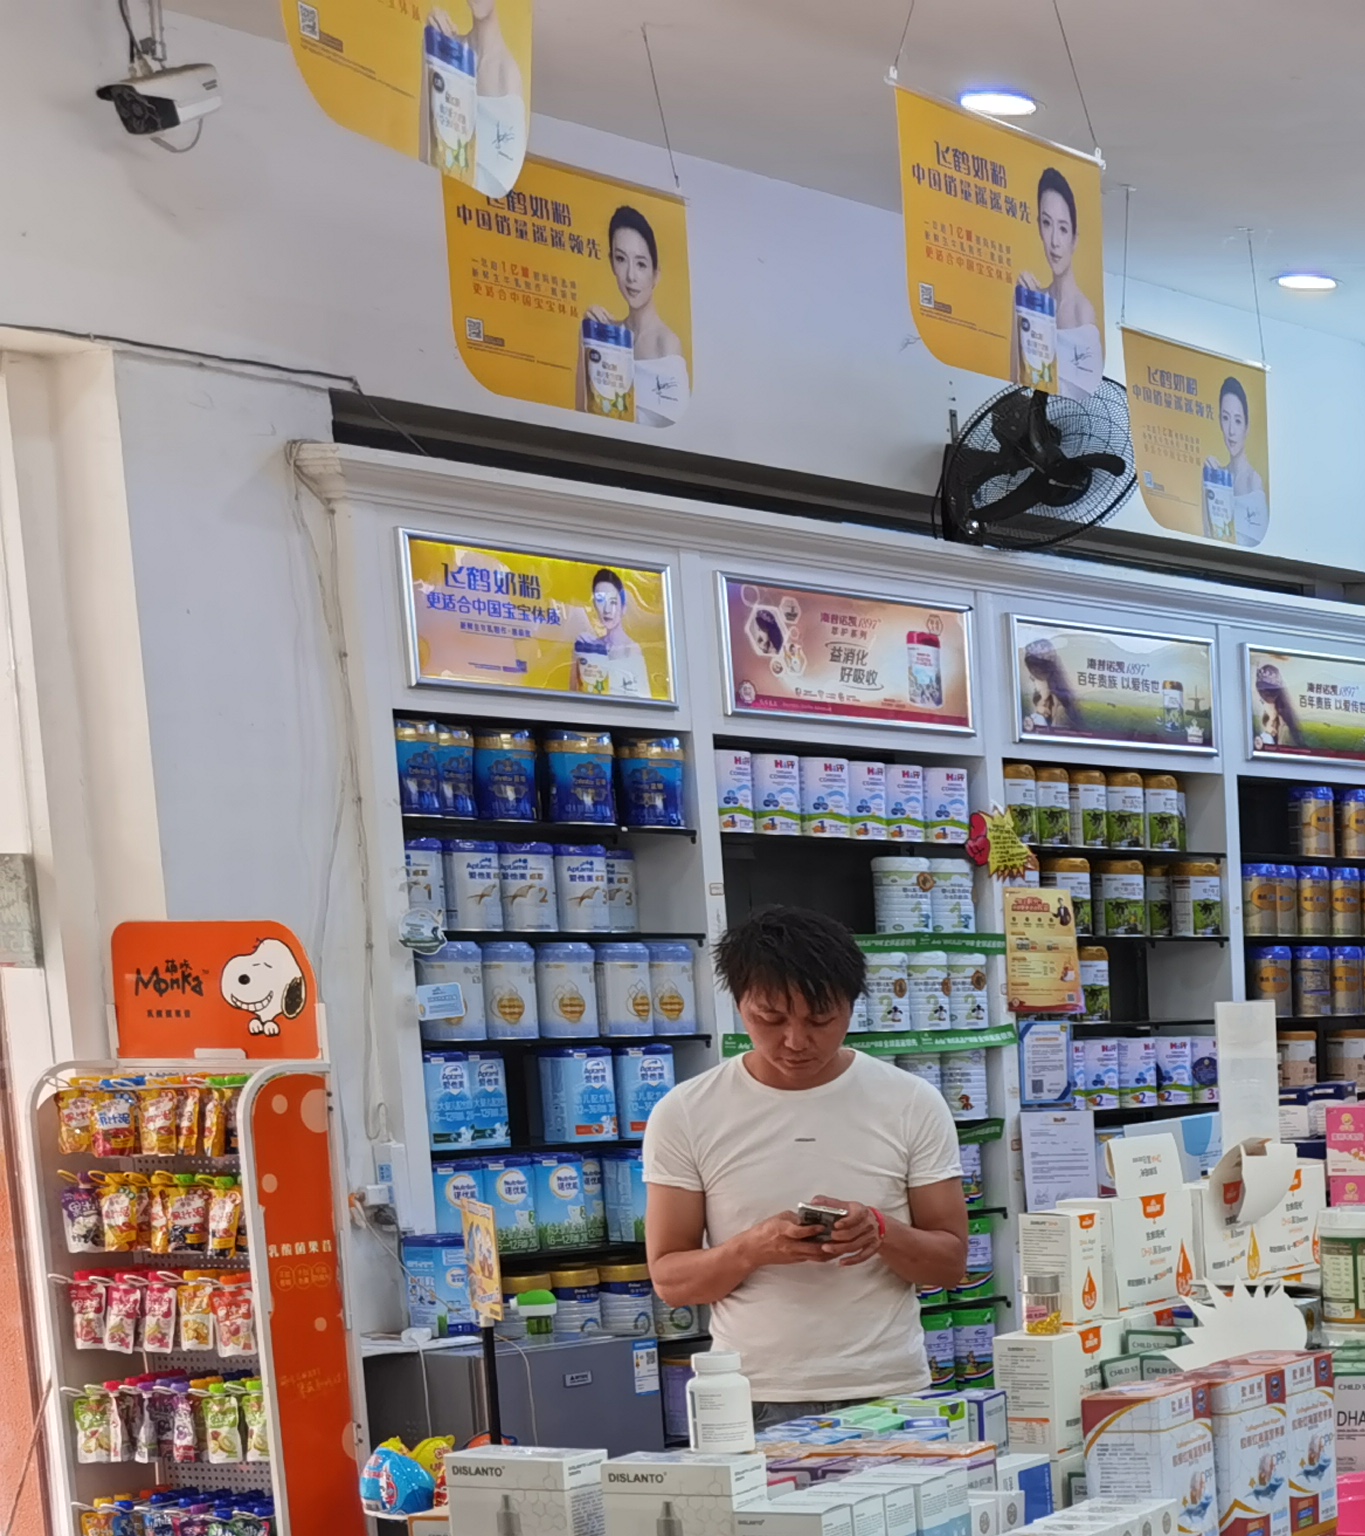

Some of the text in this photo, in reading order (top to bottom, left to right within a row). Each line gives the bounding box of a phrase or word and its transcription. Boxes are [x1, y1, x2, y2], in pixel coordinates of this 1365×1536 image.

[934, 140, 1008, 189] 飞鹤奶粉
[457, 204, 601, 260] 中国销量遥遥领先
[442, 562, 541, 600] 飞鹤奶粉
[426, 589, 561, 627] 更适合中国宝宝体质
[828, 646, 868, 667] 益消化
[1077, 672, 1161, 694] 百年贵族 以爱传世
[1298, 694, 1331, 711] 百年贵族
[1338, 1383, 1360, 1391] CHILD
[452, 1466, 503, 1477] DISLANTO
[608, 1473, 664, 1484] DISLANTO
